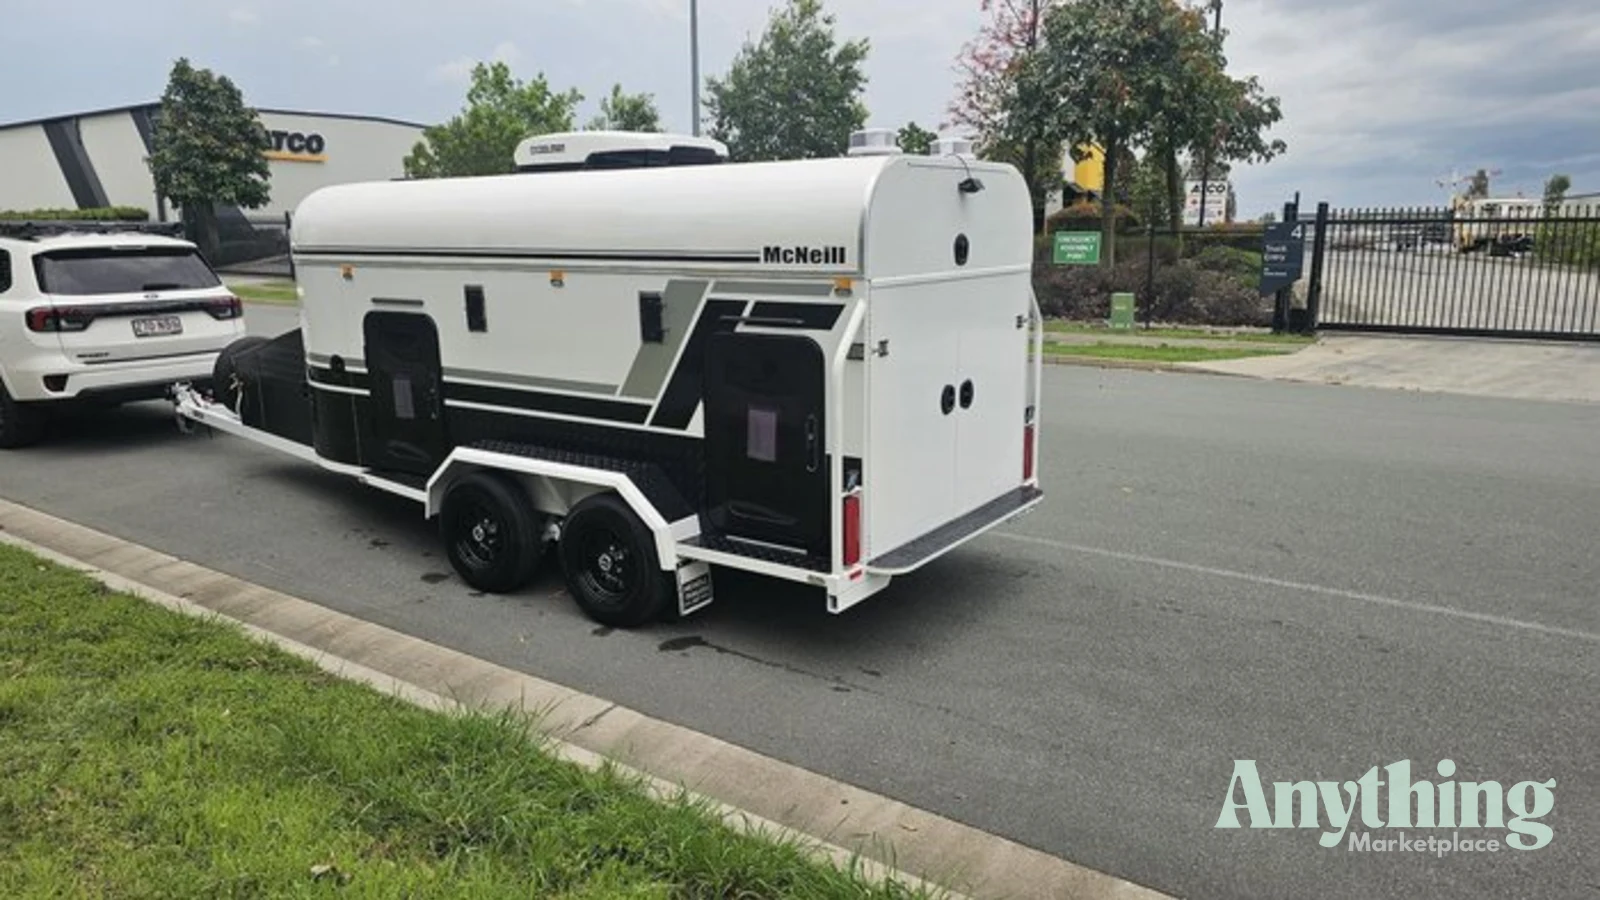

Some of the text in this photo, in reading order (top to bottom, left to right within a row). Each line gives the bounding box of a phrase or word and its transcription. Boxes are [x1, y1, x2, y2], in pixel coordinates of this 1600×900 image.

[1190, 183, 1226, 194] ACO
[1291, 224, 1302, 239] 4
[763, 246, 846, 264] McNeill
